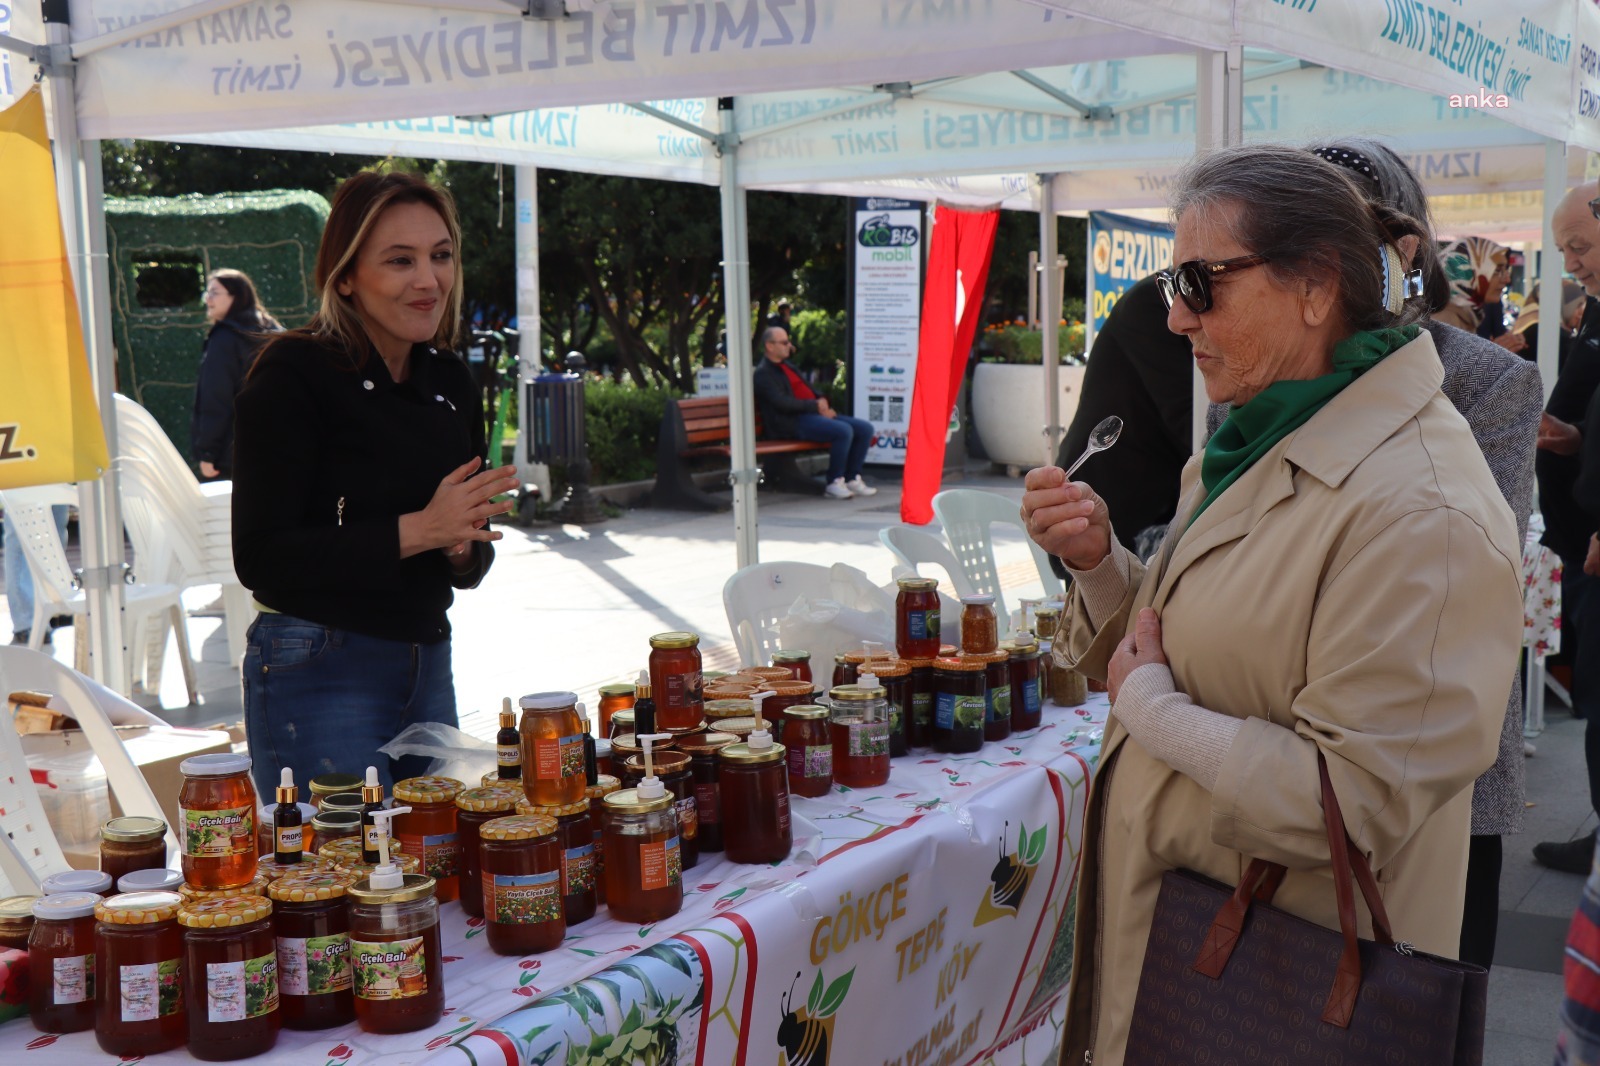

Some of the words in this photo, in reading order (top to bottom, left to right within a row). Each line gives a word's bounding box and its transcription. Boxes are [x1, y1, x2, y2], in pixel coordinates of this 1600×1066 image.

[1517, 17, 1544, 55] SANAT
[1503, 60, 1532, 101] İZMİT
[872, 243, 913, 262] mobil
[1110, 229, 1175, 281] ERZUR
[199, 817, 223, 828] Çiçek
[809, 872, 909, 966] GÖKÇE
[360, 953, 384, 965] Çiçek
[385, 951, 407, 964] Balı
[896, 906, 948, 984] TEPE
[935, 941, 982, 1010] KÖY
